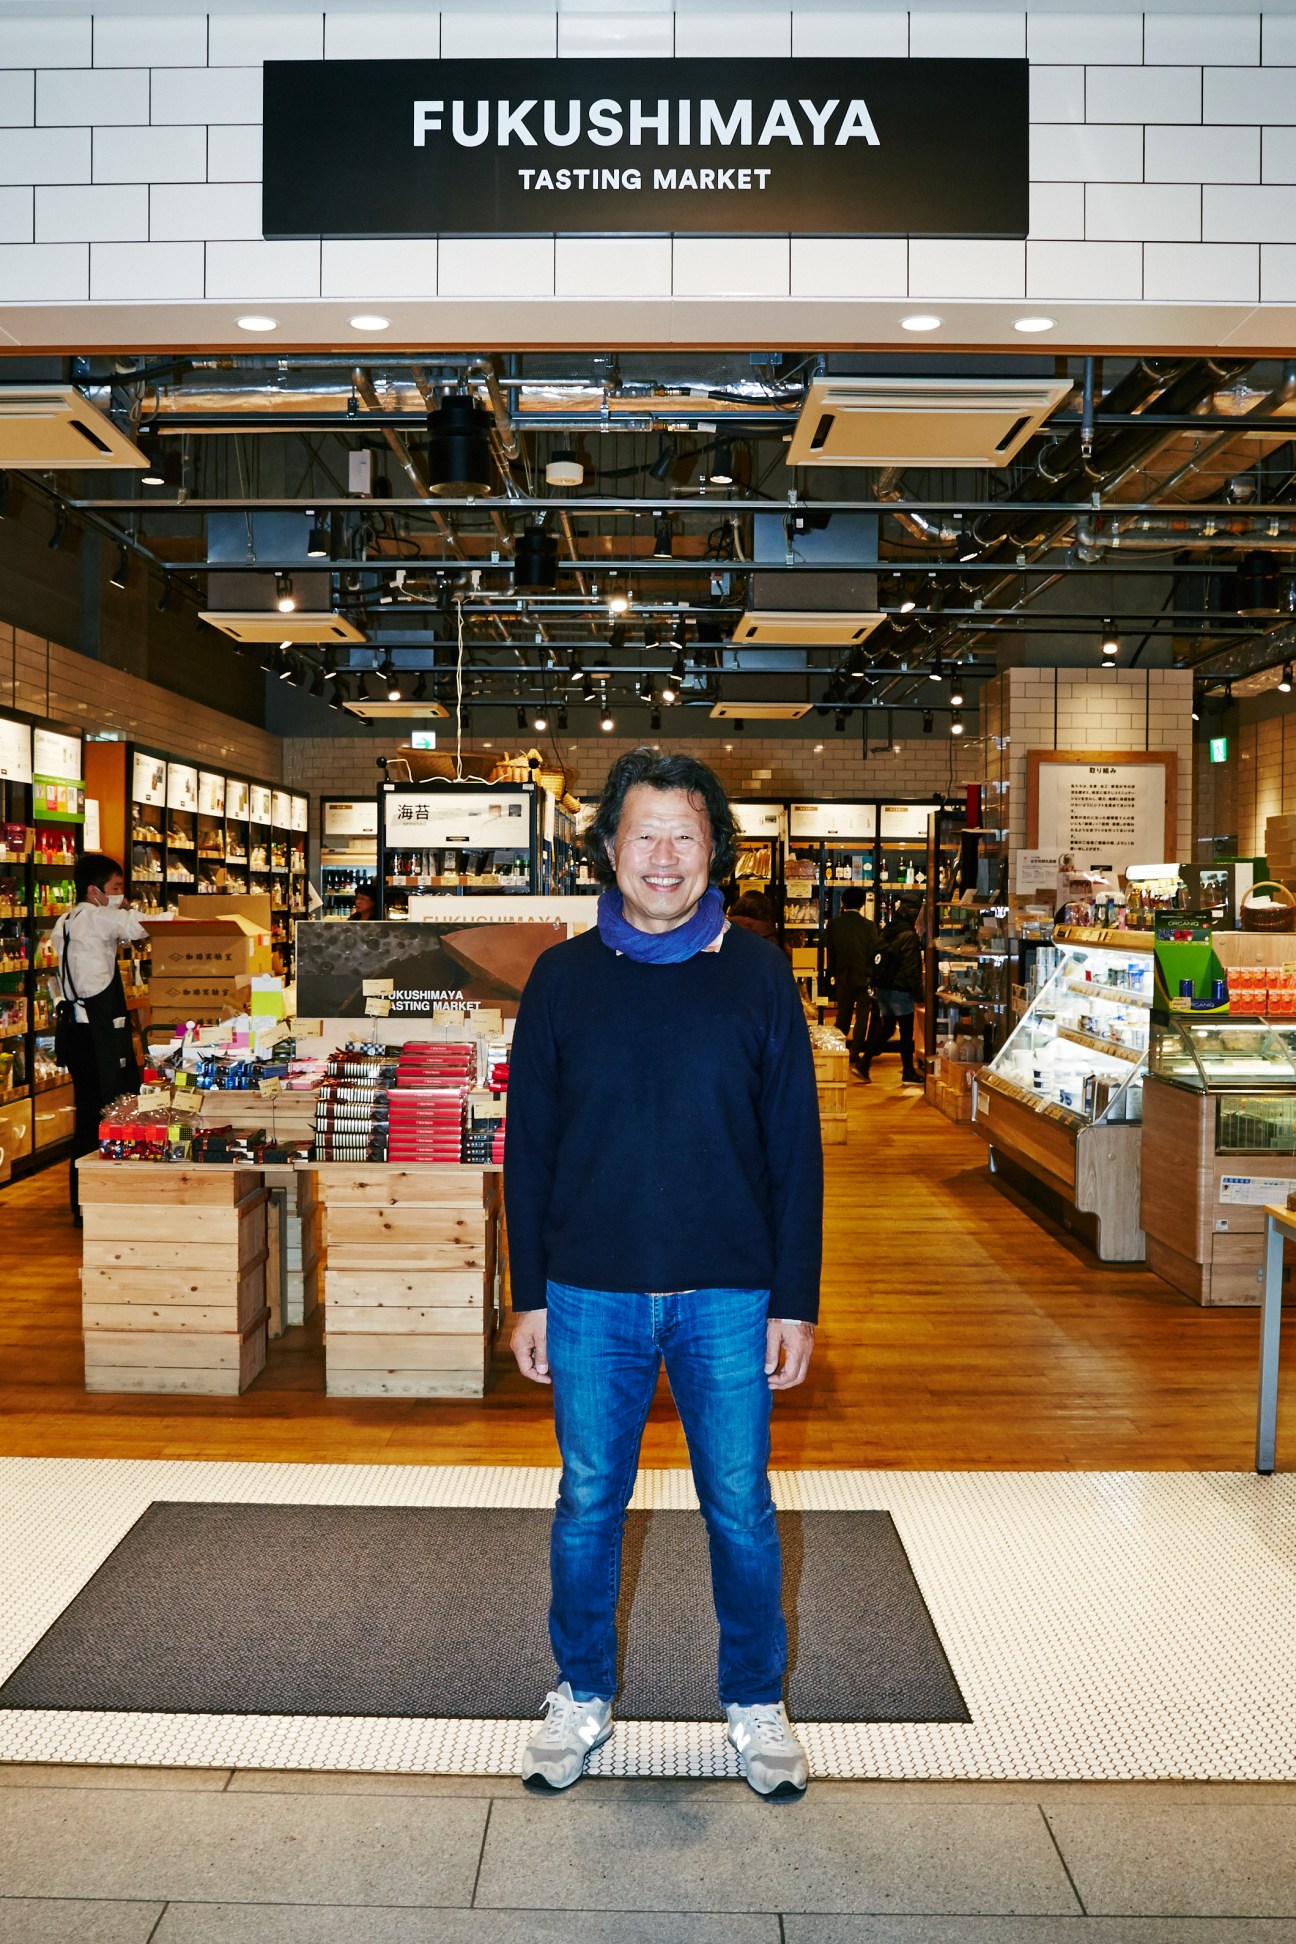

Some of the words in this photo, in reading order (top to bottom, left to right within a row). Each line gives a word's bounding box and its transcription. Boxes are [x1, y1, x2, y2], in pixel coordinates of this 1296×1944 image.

[413, 99, 881, 148] FUKUSHIMAYA
[518, 168, 642, 190] TASTING
[652, 168, 772, 190] MARKET
[397, 804, 430, 820] 海苔
[382, 989, 464, 1001] UKUSHIMAYA
[433, 1000, 482, 1010] MARKET
